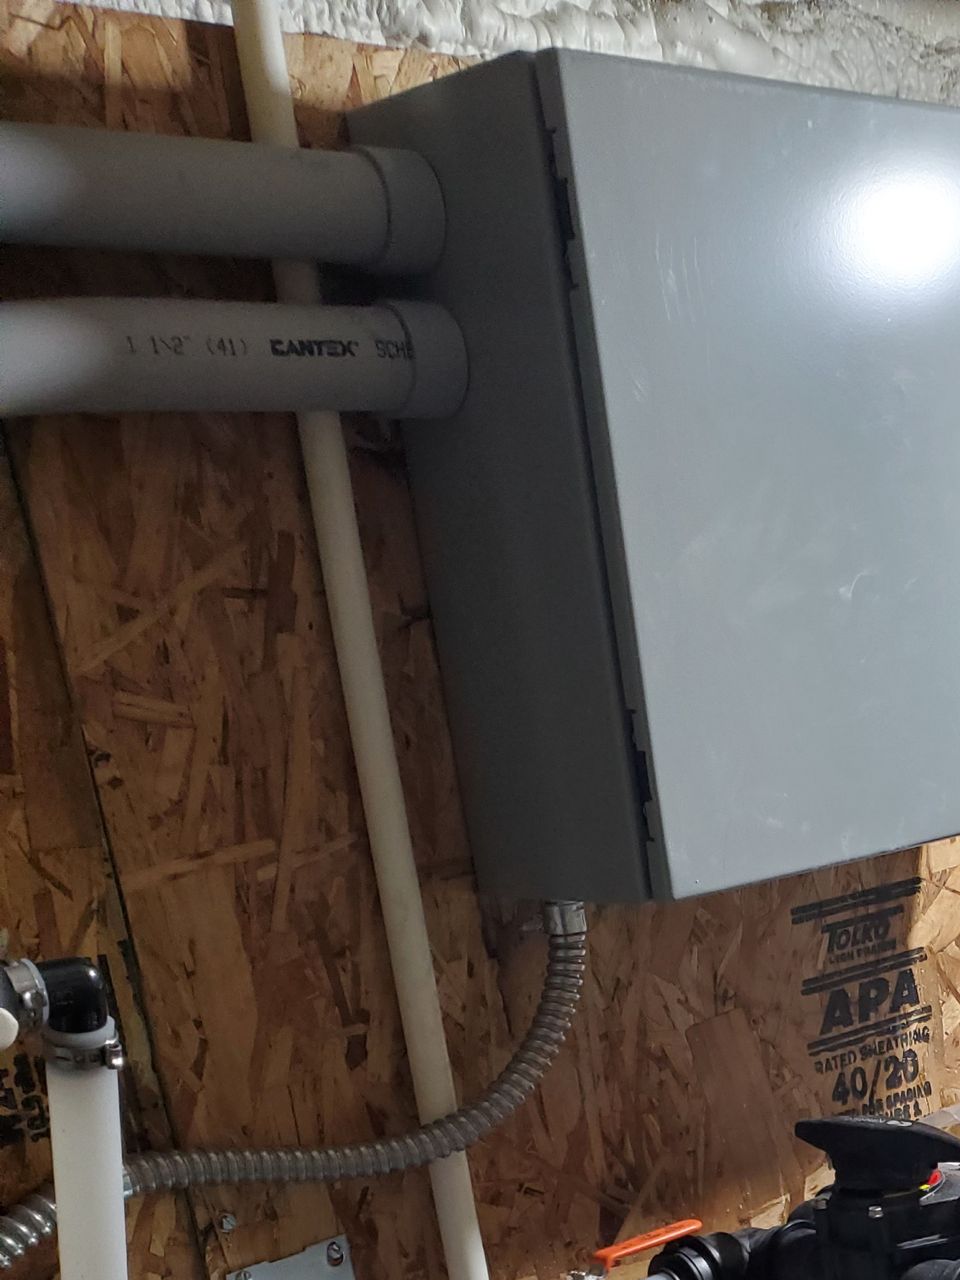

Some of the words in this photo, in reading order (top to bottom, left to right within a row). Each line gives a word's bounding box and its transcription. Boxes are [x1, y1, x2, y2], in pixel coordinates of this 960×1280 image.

[269, 338, 359, 357] CANTEX
[819, 968, 920, 1036] APA
[814, 1050, 857, 1074] RATED
[859, 1025, 930, 1061] SHEATHING
[831, 1048, 919, 1115] 40/20
